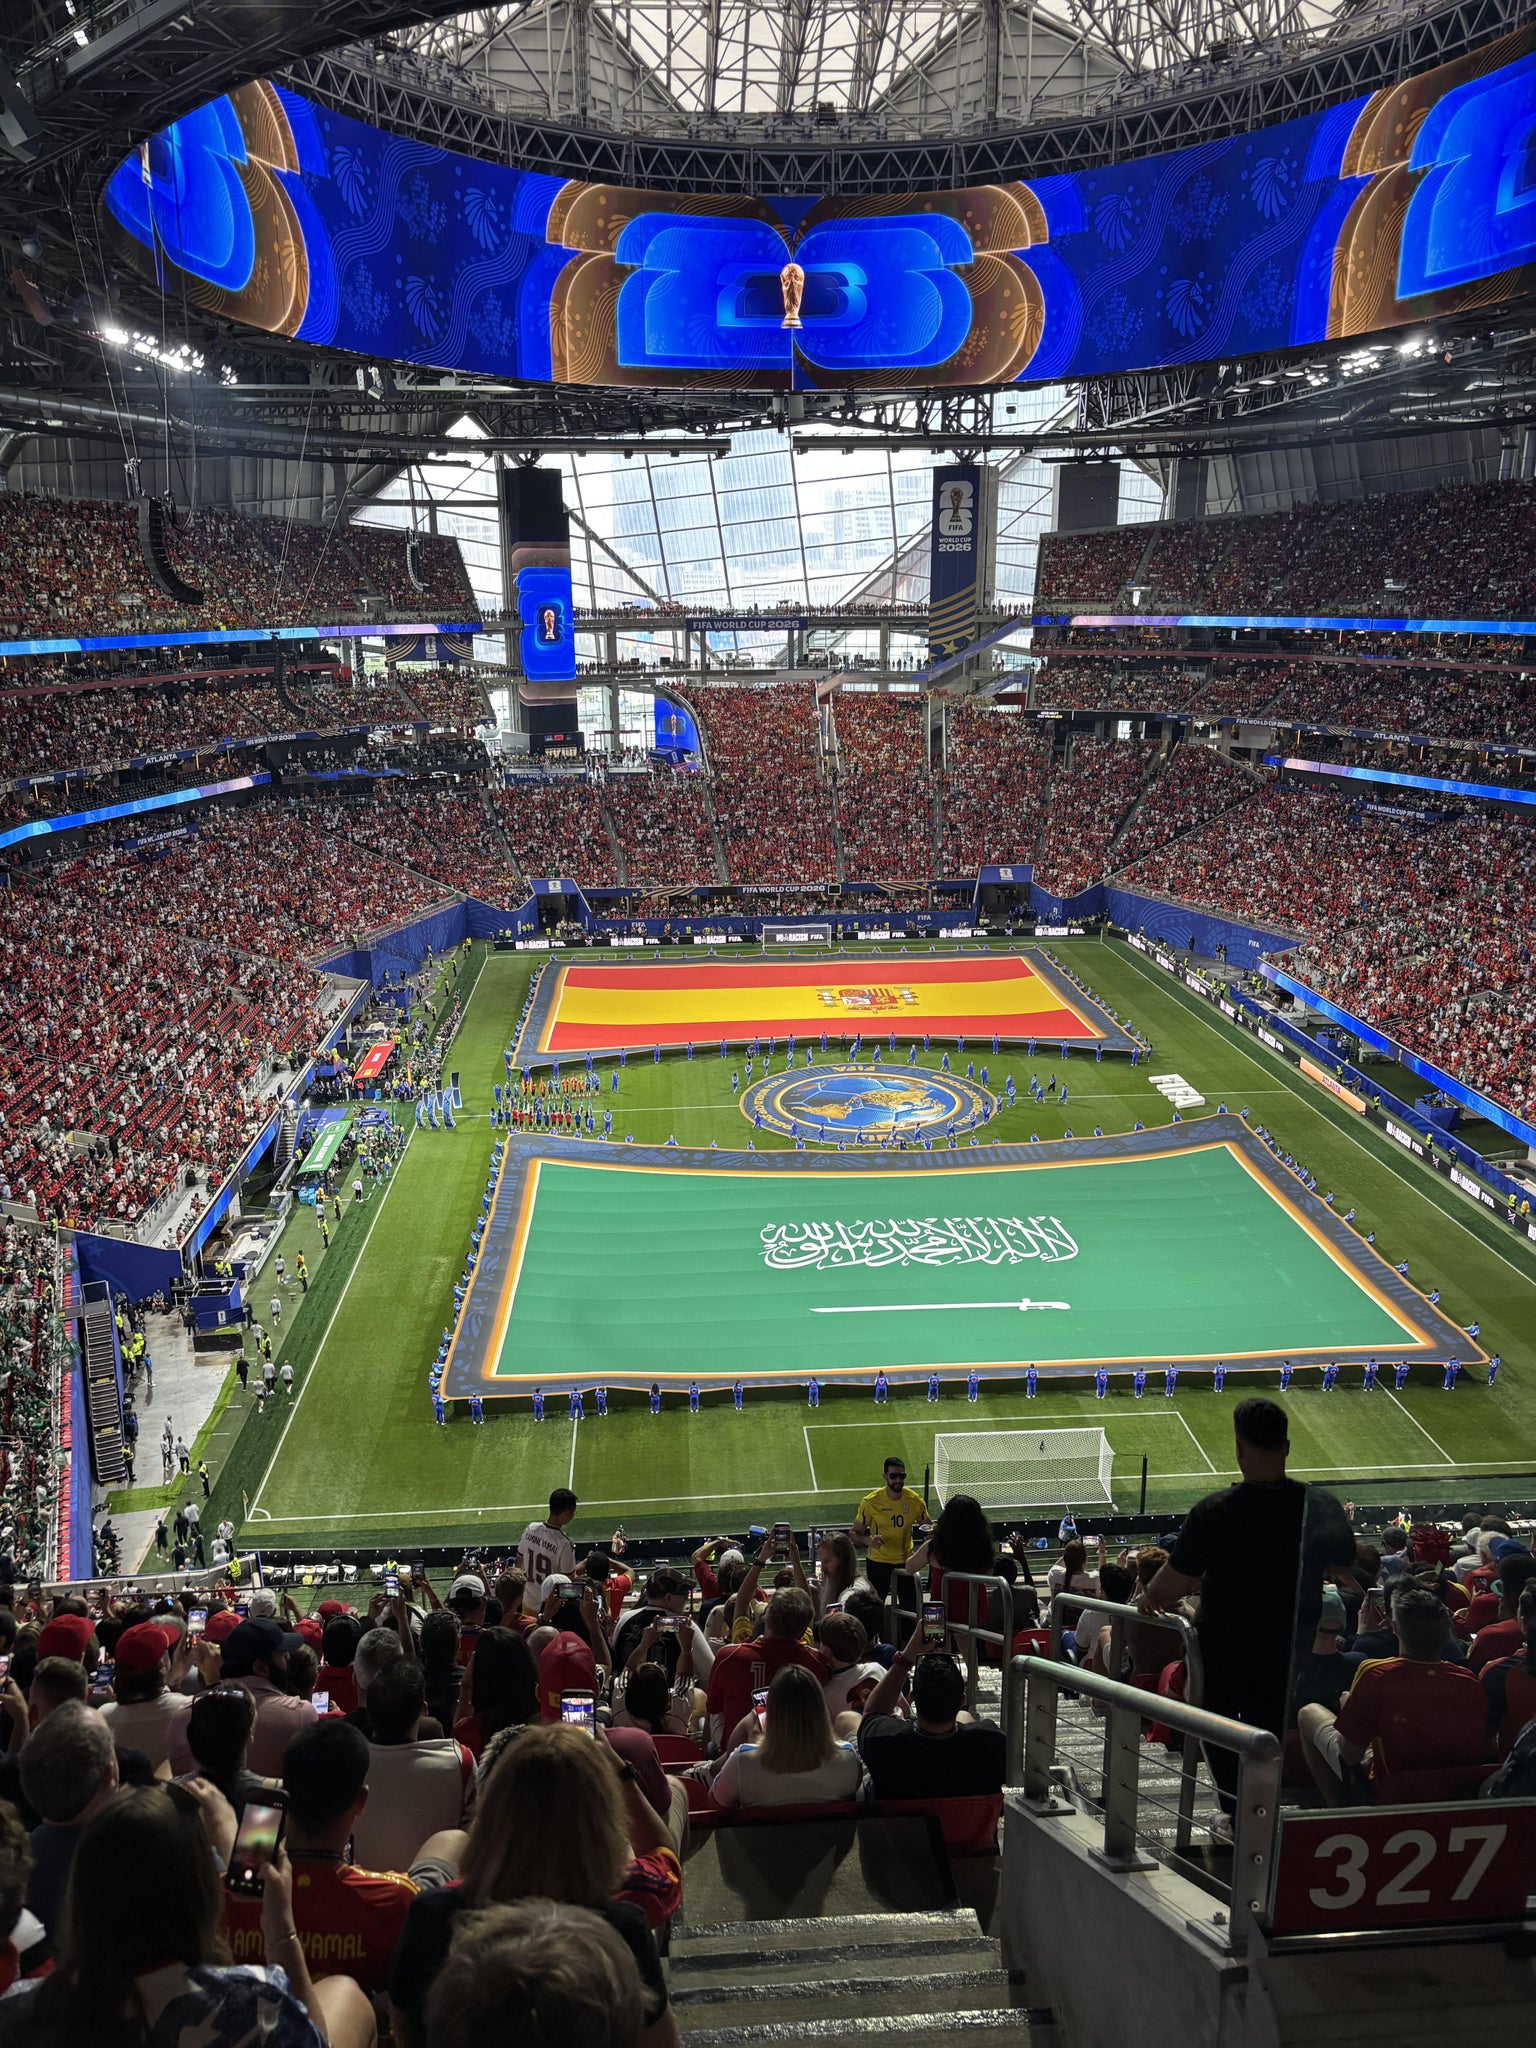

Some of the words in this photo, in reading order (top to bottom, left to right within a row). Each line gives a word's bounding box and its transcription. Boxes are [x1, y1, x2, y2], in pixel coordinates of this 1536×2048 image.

[938, 543, 972, 552] 2026
[693, 621, 713, 630] FIFA
[714, 621, 747, 629] WORLD
[748, 620, 767, 629] CUP
[768, 620, 800, 629] 2026
[374, 723, 415, 731] ATLANTA
[1373, 732, 1411, 742] ATLANTA
[145, 753, 178, 765] ATLANTA
[1378, 805, 1396, 814] WORLD
[1396, 808, 1407, 816] CUP
[1248, 939, 1260, 949] FIFA
[1322, 1076, 1341, 1095] ATLANTA
[890, 1514, 904, 1528] 10
[526, 1532, 542, 1546] LAMINE
[542, 1539, 558, 1554] YAMAL
[528, 1547, 552, 1585] 19
[1309, 1824, 1508, 1910] 327
[299, 1931, 367, 1960] YAMAL
